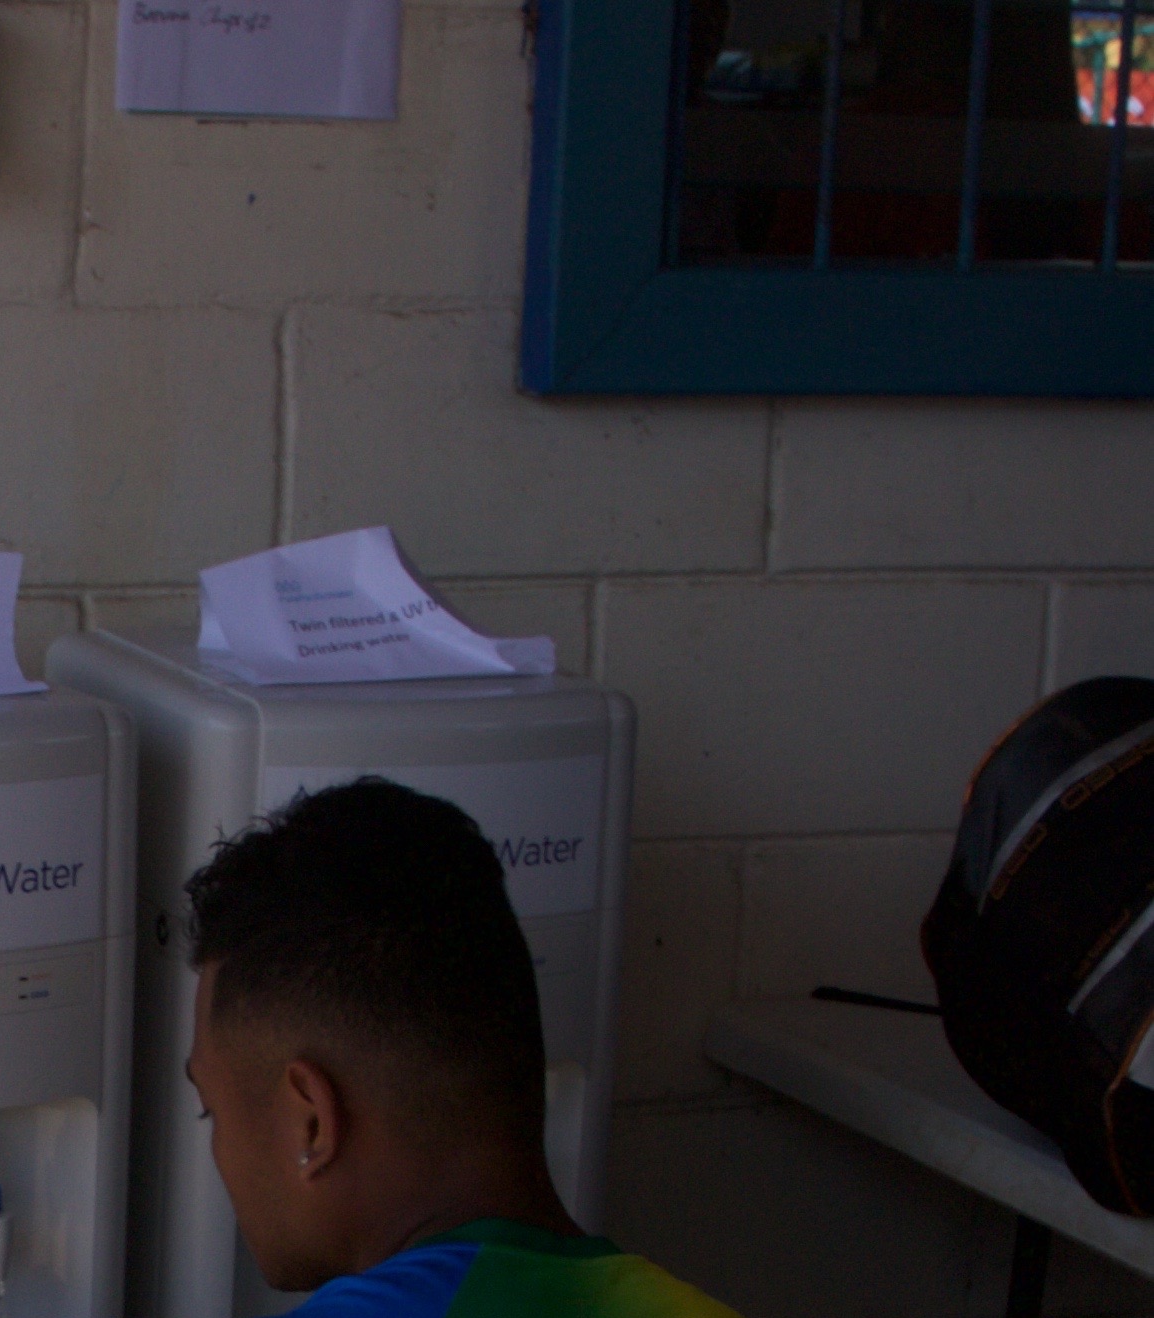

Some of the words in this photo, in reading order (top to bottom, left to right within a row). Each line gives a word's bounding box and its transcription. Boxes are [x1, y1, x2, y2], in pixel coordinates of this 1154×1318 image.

[289, 618, 326, 634] Twin
[328, 611, 385, 630] filtered
[402, 602, 423, 620] UV
[297, 639, 363, 657] Drinking
